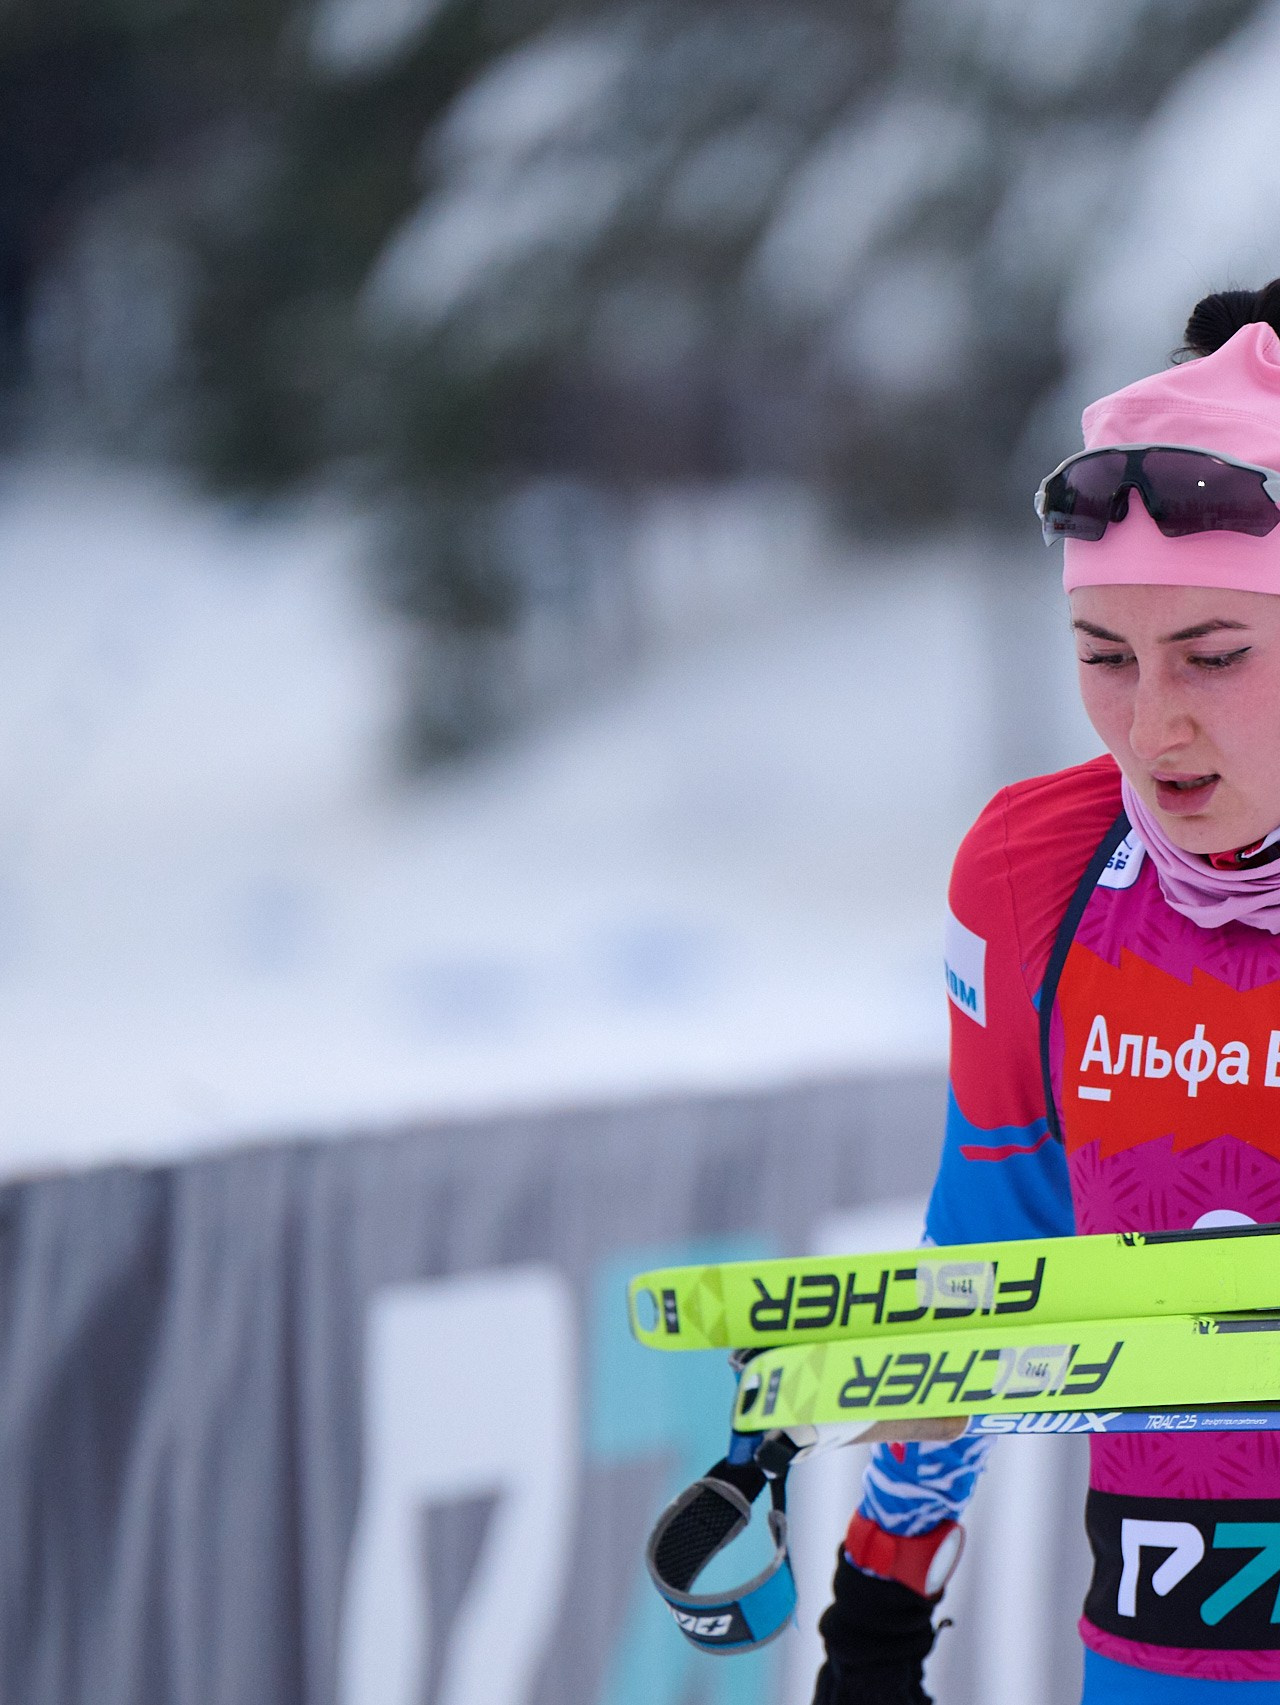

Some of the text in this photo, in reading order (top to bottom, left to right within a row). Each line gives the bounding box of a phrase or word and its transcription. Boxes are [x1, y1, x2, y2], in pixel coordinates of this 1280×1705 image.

[1080, 1014, 1251, 1099] Альфа
[749, 1256, 1046, 1332] FISCHER
[837, 1340, 1125, 1409] FISCHER
[973, 1412, 1123, 1435] SWIX
